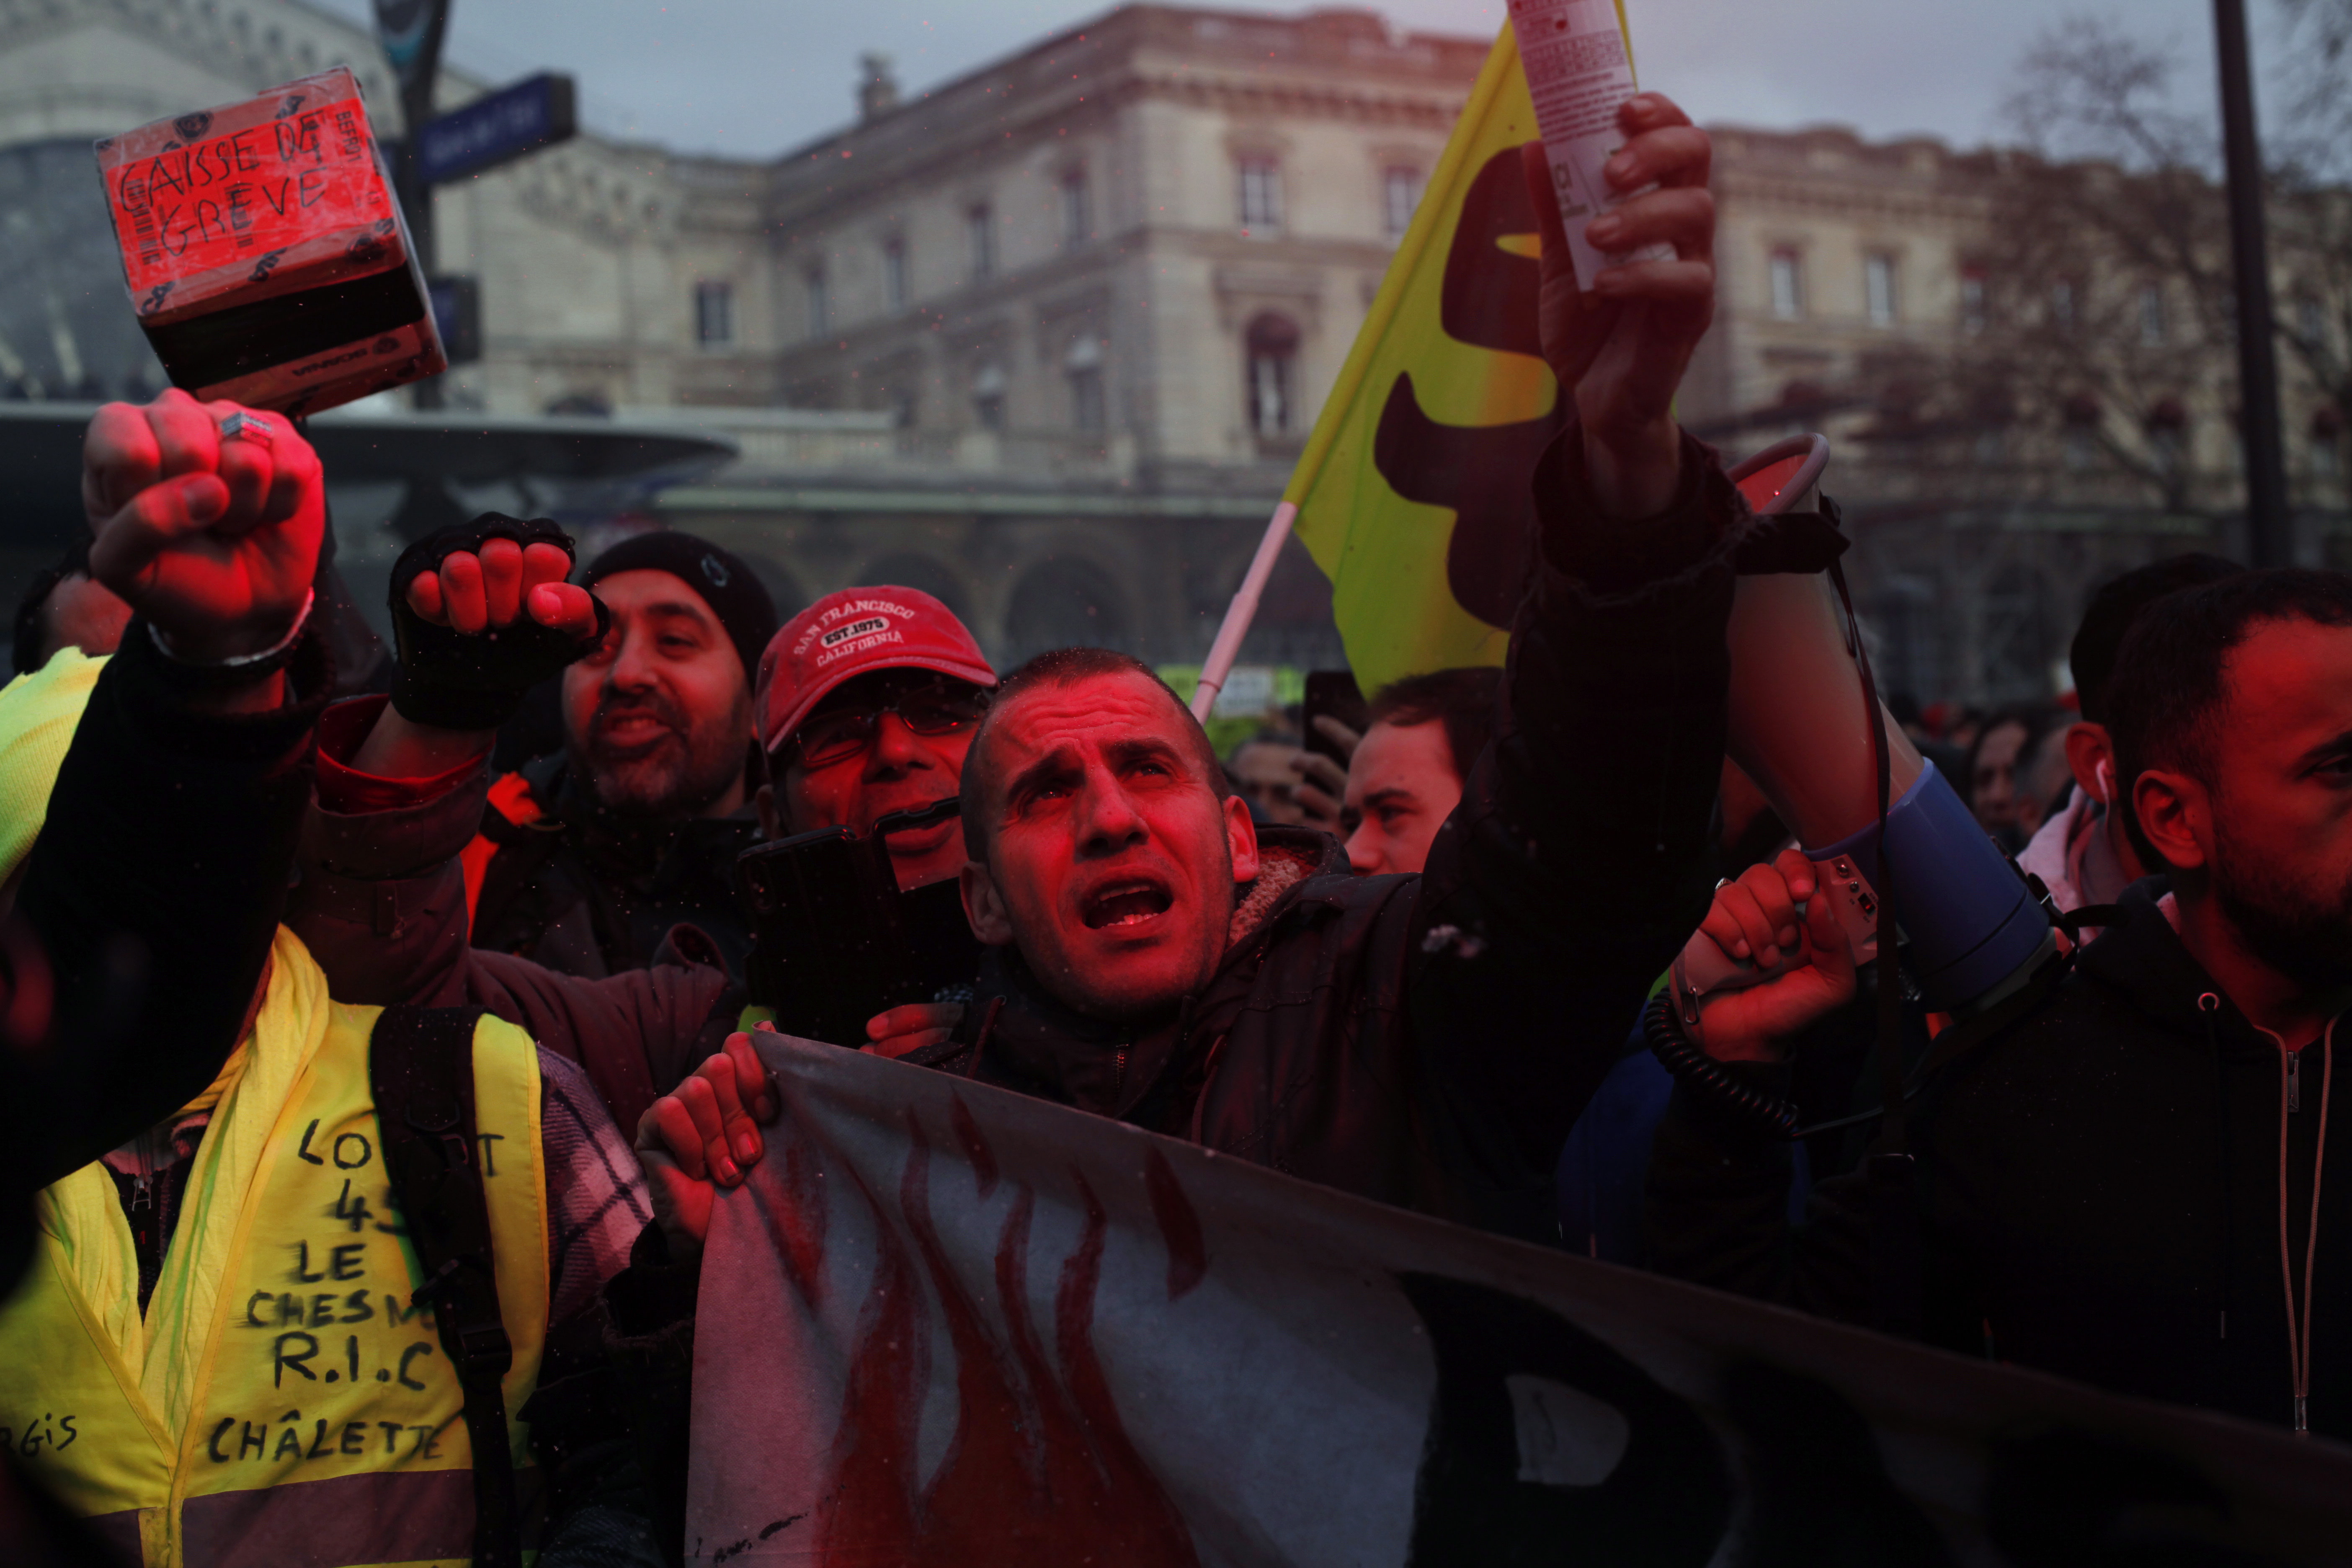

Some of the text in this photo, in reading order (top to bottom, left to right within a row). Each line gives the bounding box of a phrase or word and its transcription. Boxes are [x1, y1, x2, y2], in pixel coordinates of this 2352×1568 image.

[121, 110, 325, 212] CAISSE DE
[794, 600, 915, 655] SAN FRANCISCO
[816, 629, 904, 668] CALIFORNIA
[824, 618, 884, 645] EST.1975
[297, 1240, 367, 1283] LE
[209, 1409, 444, 1463] CHÂLETTE
